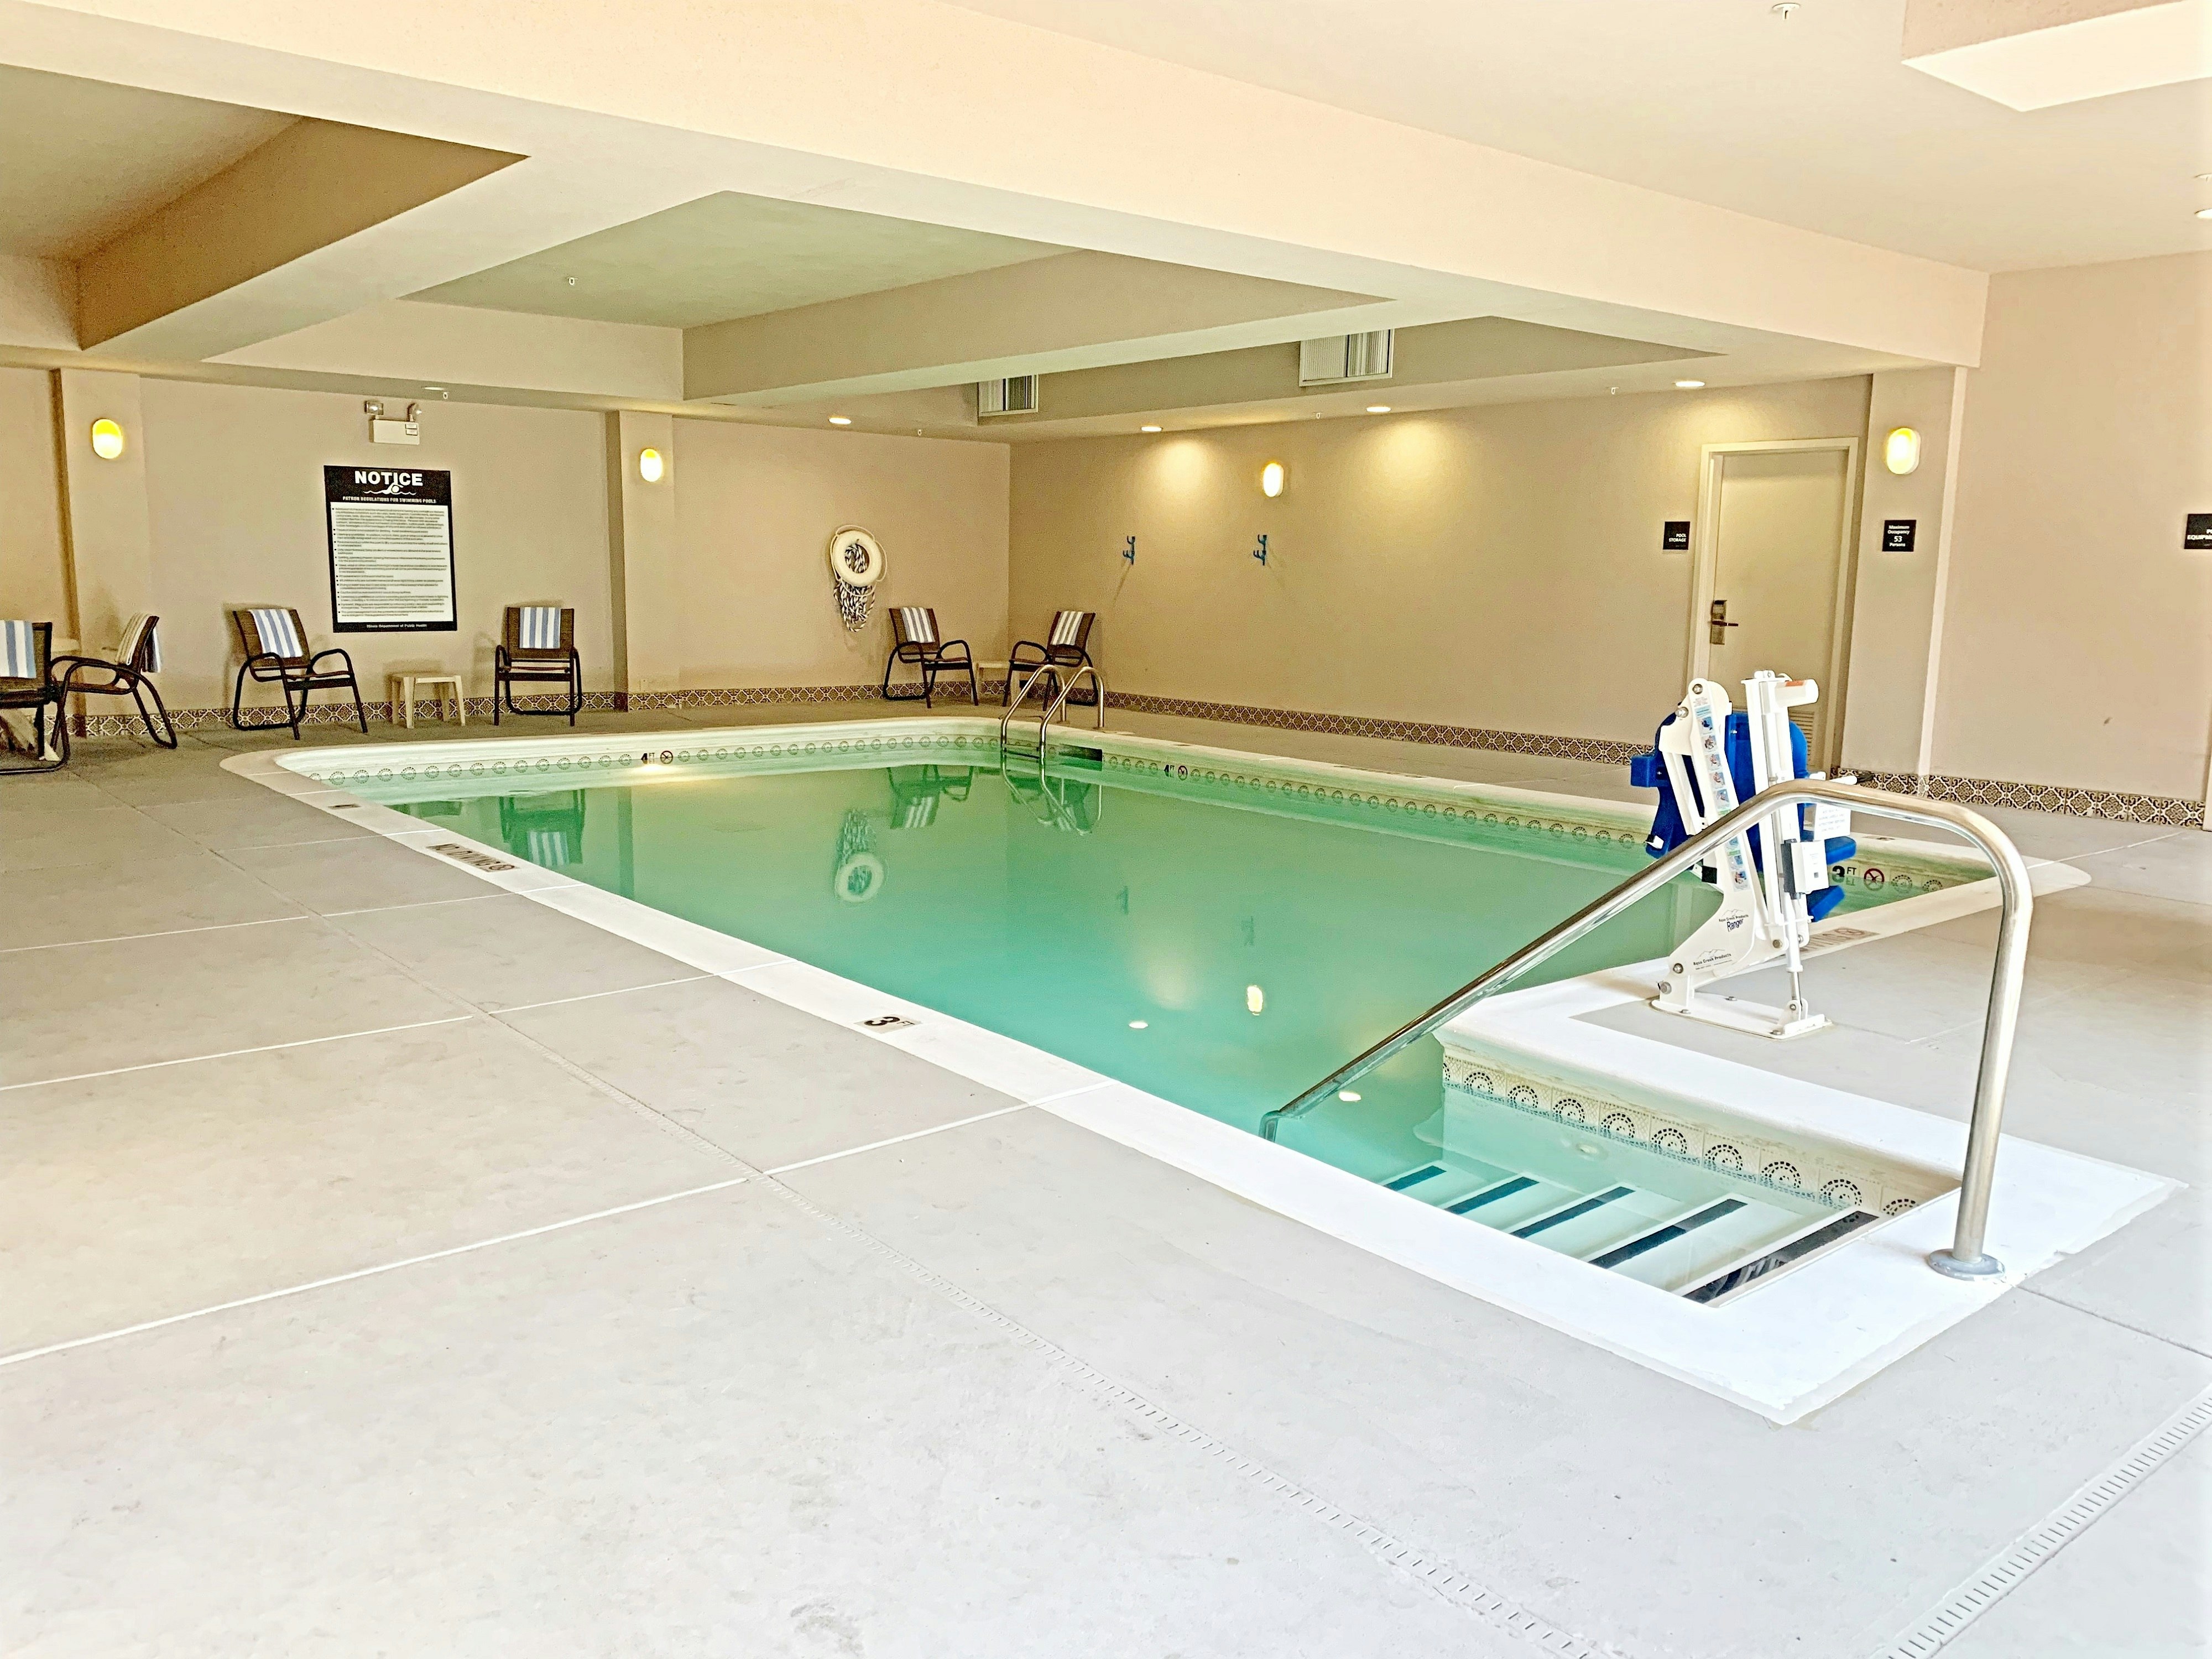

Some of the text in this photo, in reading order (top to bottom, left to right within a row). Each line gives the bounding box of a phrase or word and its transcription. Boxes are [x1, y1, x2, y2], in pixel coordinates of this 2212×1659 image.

[354, 471, 423, 486] NOTICE
[1846, 867, 1857, 875] FT
[1726, 919, 1744, 932] Ranger
[864, 1016, 900, 1026] 3
